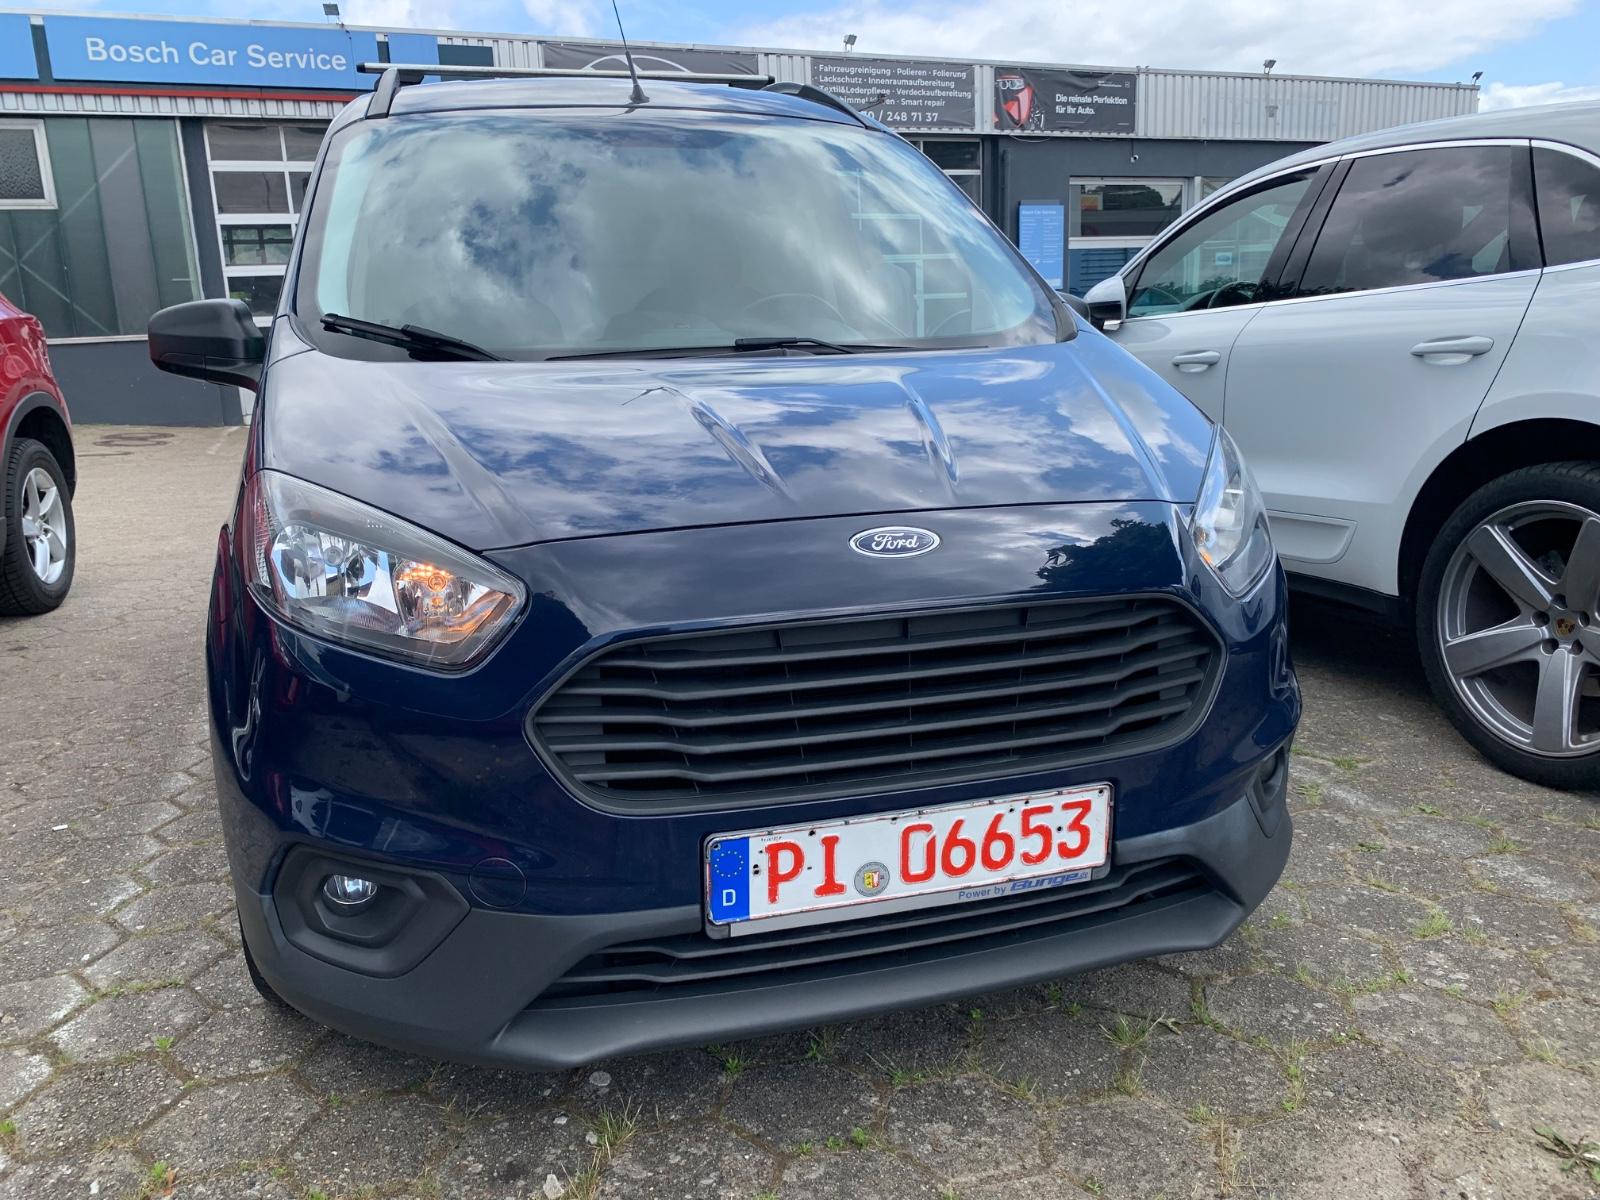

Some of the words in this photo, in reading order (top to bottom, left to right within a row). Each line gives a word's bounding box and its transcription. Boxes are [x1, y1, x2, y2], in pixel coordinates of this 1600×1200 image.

[86, 37, 179, 64] Bosch
[189, 41, 237, 67] Car
[247, 44, 347, 71] Service
[819, 64, 891, 76] Fahrzeugreinigung
[897, 68, 927, 76] Polieren
[932, 69, 967, 79] Folierung
[819, 75, 863, 84] Lackschutz
[868, 77, 955, 89] Innenraumaufbereitung
[896, 88, 972, 99] Verdeckaufbereitung
[1055, 93, 1068, 103] Die
[1068, 94, 1092, 103] reinste
[1092, 95, 1128, 105] Perfektion
[901, 98, 923, 106] Smart
[924, 99, 946, 107] repair
[886, 111, 908, 122] 248
[911, 112, 922, 122] 71
[925, 112, 939, 122] 37
[1055, 105, 1066, 114] für
[1066, 105, 1077, 114] Ihr
[1077, 106, 1095, 115] Auto.
[871, 532, 919, 551] Ford
[722, 888, 736, 907] D
[764, 834, 848, 905] PI
[900, 798, 1093, 885] 06653
[958, 888, 991, 901] Power
[994, 886, 1007, 896] by
